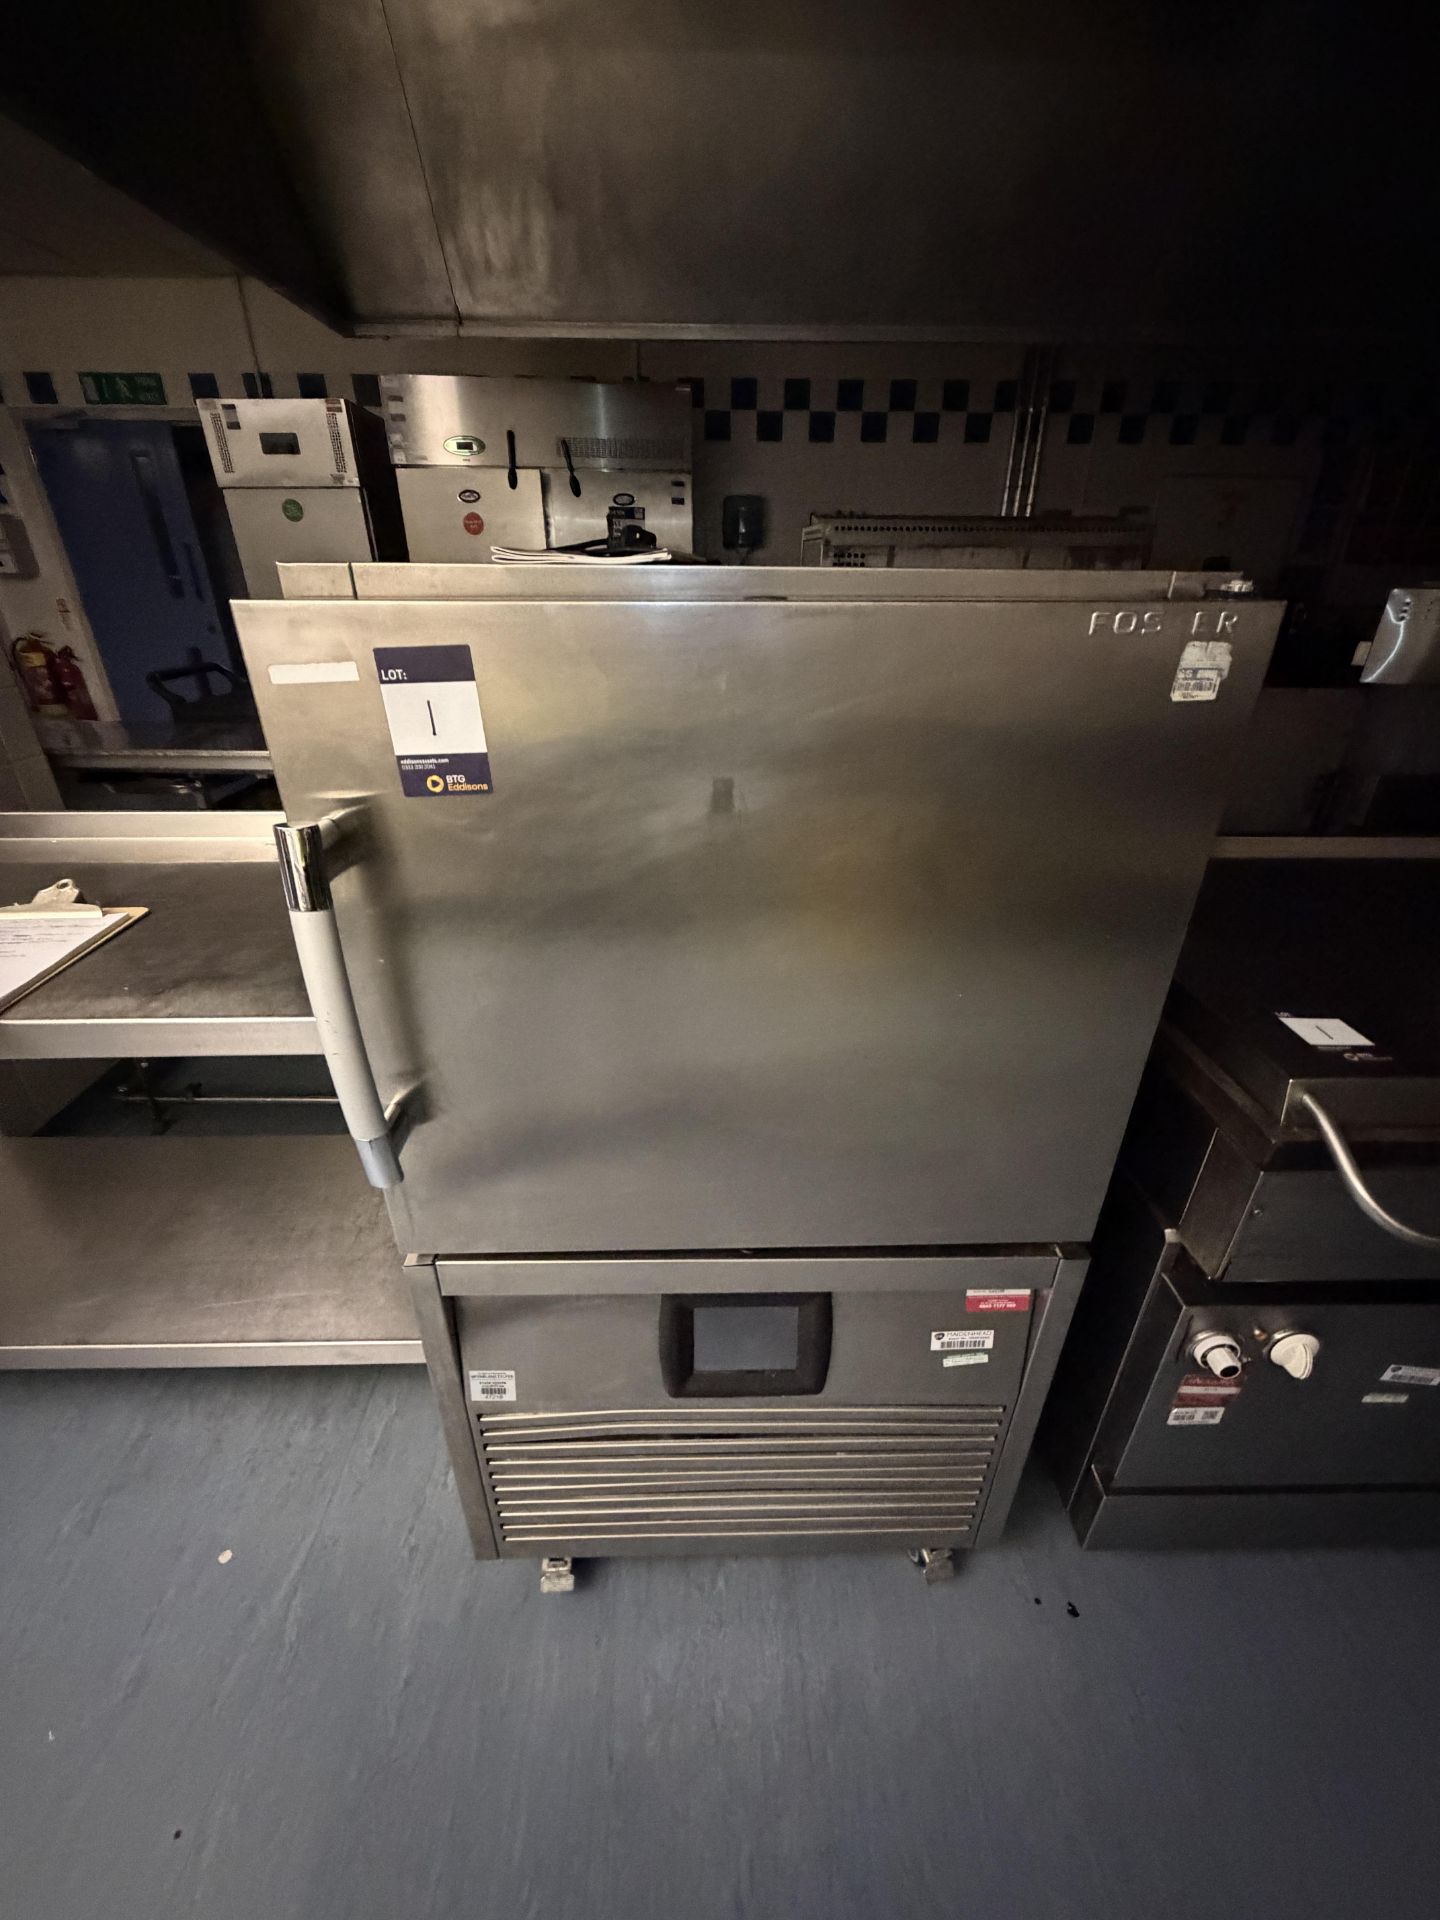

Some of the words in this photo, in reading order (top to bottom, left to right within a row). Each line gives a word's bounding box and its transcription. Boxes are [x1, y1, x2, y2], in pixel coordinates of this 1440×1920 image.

[380, 669, 408, 681] LOT:
[446, 774, 466, 784] BTG
[448, 782, 489, 791] Eddisons
